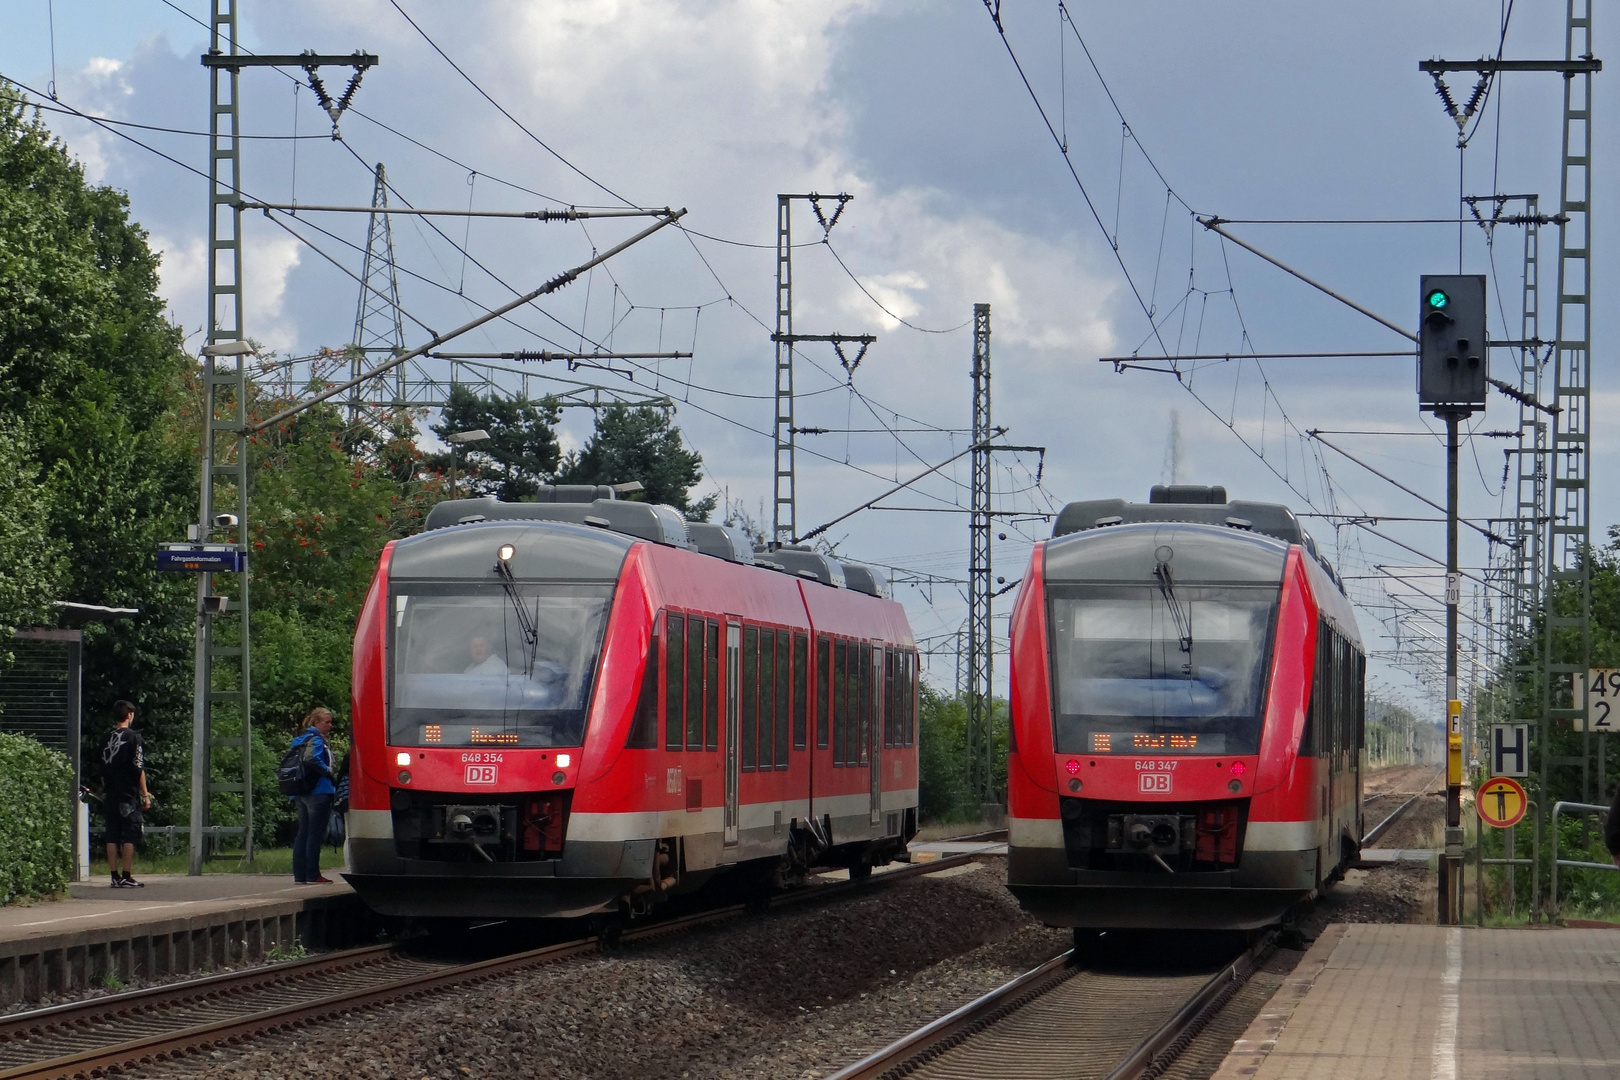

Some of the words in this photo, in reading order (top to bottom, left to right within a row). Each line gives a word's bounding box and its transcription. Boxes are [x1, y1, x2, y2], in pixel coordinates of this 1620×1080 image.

[1448, 576, 1456, 588] P
[1446, 589, 1459, 600] 701
[1579, 672, 1620, 697] 49
[1594, 701, 1611, 726] 2
[1452, 716, 1459, 731] F
[1480, 741, 1489, 750] 14
[1495, 728, 1524, 772] H
[461, 753, 481, 763] 648
[483, 753, 503, 763] 354
[1135, 761, 1155, 770] 648
[1157, 761, 1178, 771] 347
[469, 767, 494, 782] DB
[1143, 775, 1168, 790] DB
